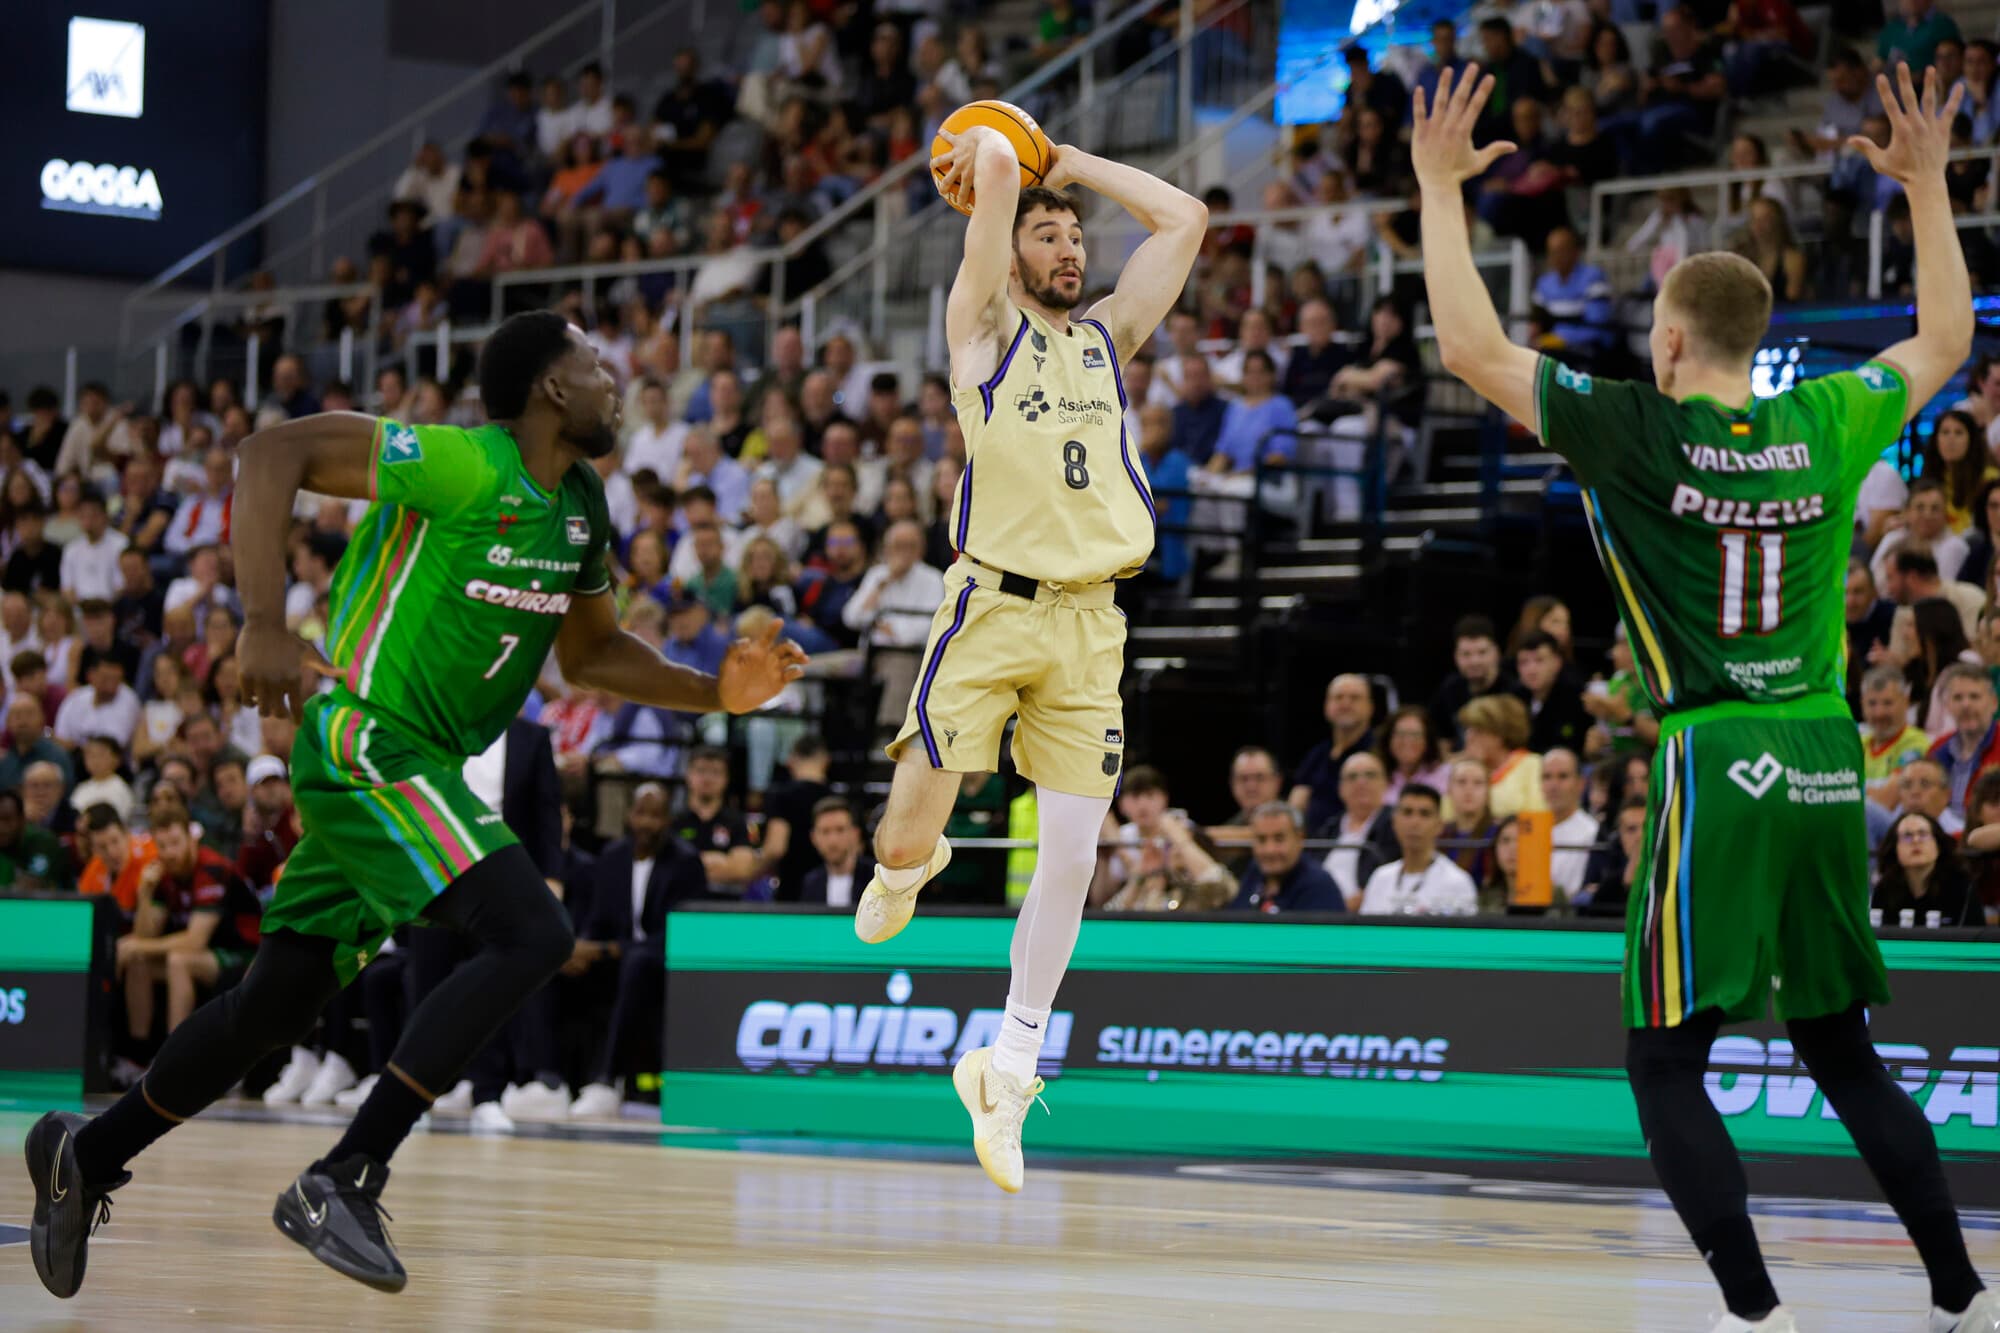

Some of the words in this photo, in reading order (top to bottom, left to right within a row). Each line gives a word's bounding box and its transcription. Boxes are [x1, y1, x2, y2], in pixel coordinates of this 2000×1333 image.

[1063, 440, 1090, 490] 8
[1682, 443, 1811, 472] VALTONEN
[1671, 483, 1824, 527] PULEVA
[487, 544, 513, 567] 65
[465, 579, 571, 615] COVIRAN
[1717, 529, 1787, 637] 11
[483, 634, 520, 680] 7
[1097, 1025, 1449, 1082] supercercanos
